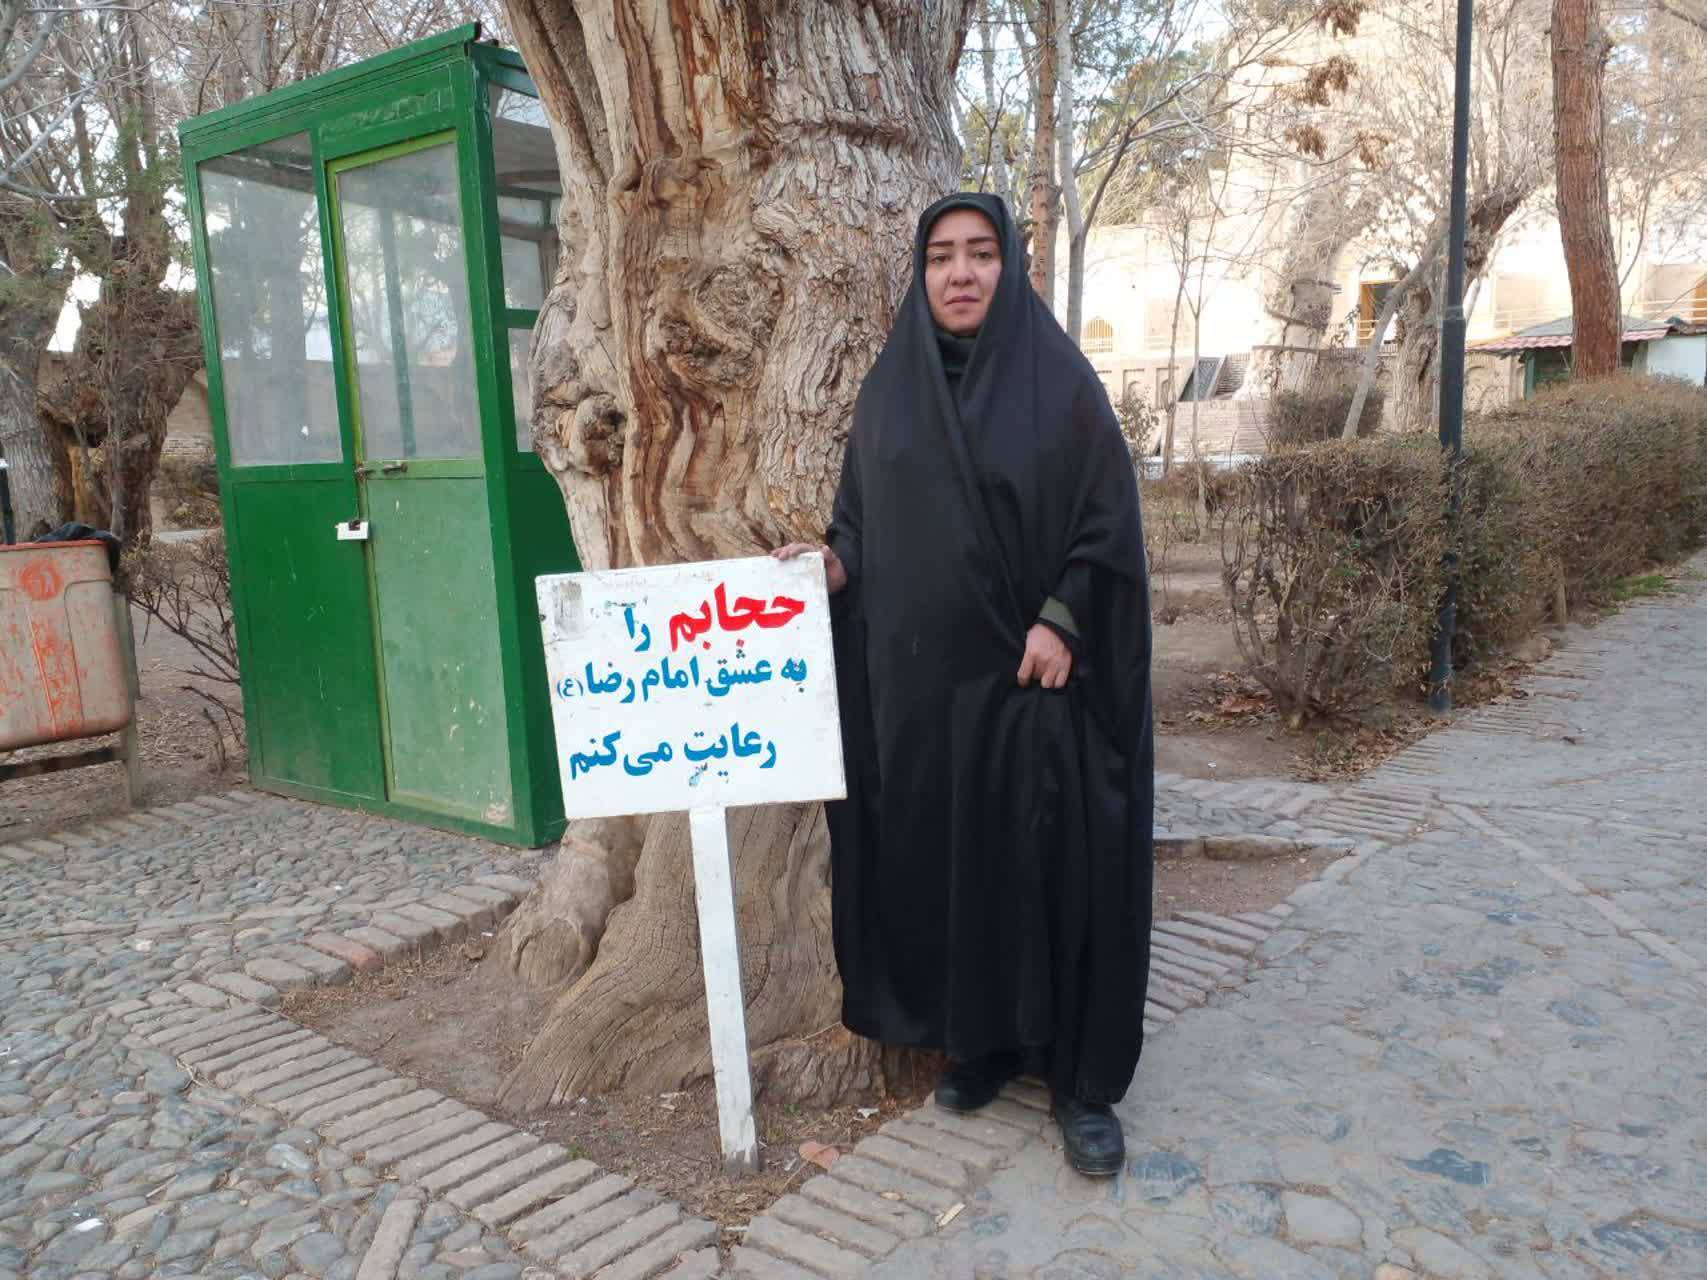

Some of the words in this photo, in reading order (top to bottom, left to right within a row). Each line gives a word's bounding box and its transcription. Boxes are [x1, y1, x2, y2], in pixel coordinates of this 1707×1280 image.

[623, 606, 652, 652] را
[669, 583, 805, 650] حجابم
[641, 655, 700, 702] امام
[705, 648, 774, 697] عشق
[780, 656, 808, 693] به
[683, 723, 777, 777] رعایت
